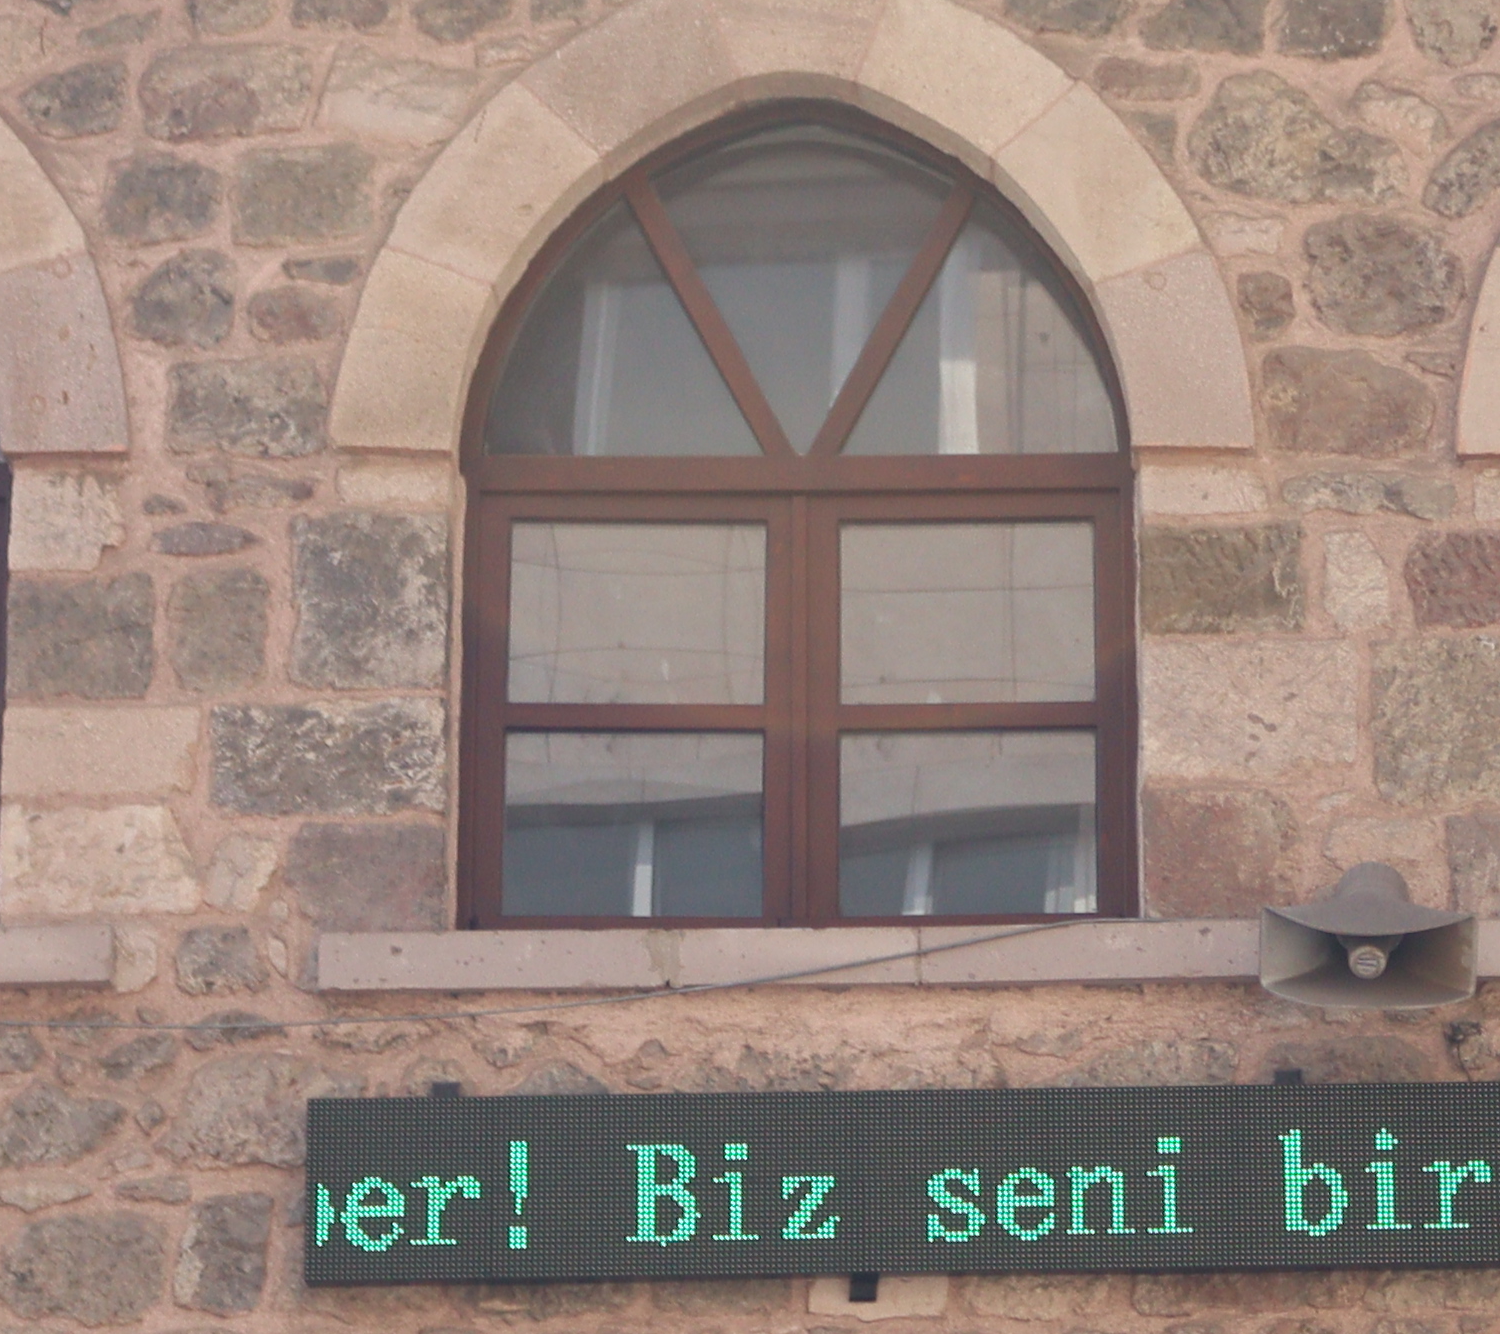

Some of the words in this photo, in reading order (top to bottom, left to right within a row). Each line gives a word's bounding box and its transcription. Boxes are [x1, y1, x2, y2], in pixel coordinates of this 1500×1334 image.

[625, 1143, 841, 1247] Biz
[927, 1136, 1194, 1242] seni
[1278, 1128, 1492, 1237] bir
